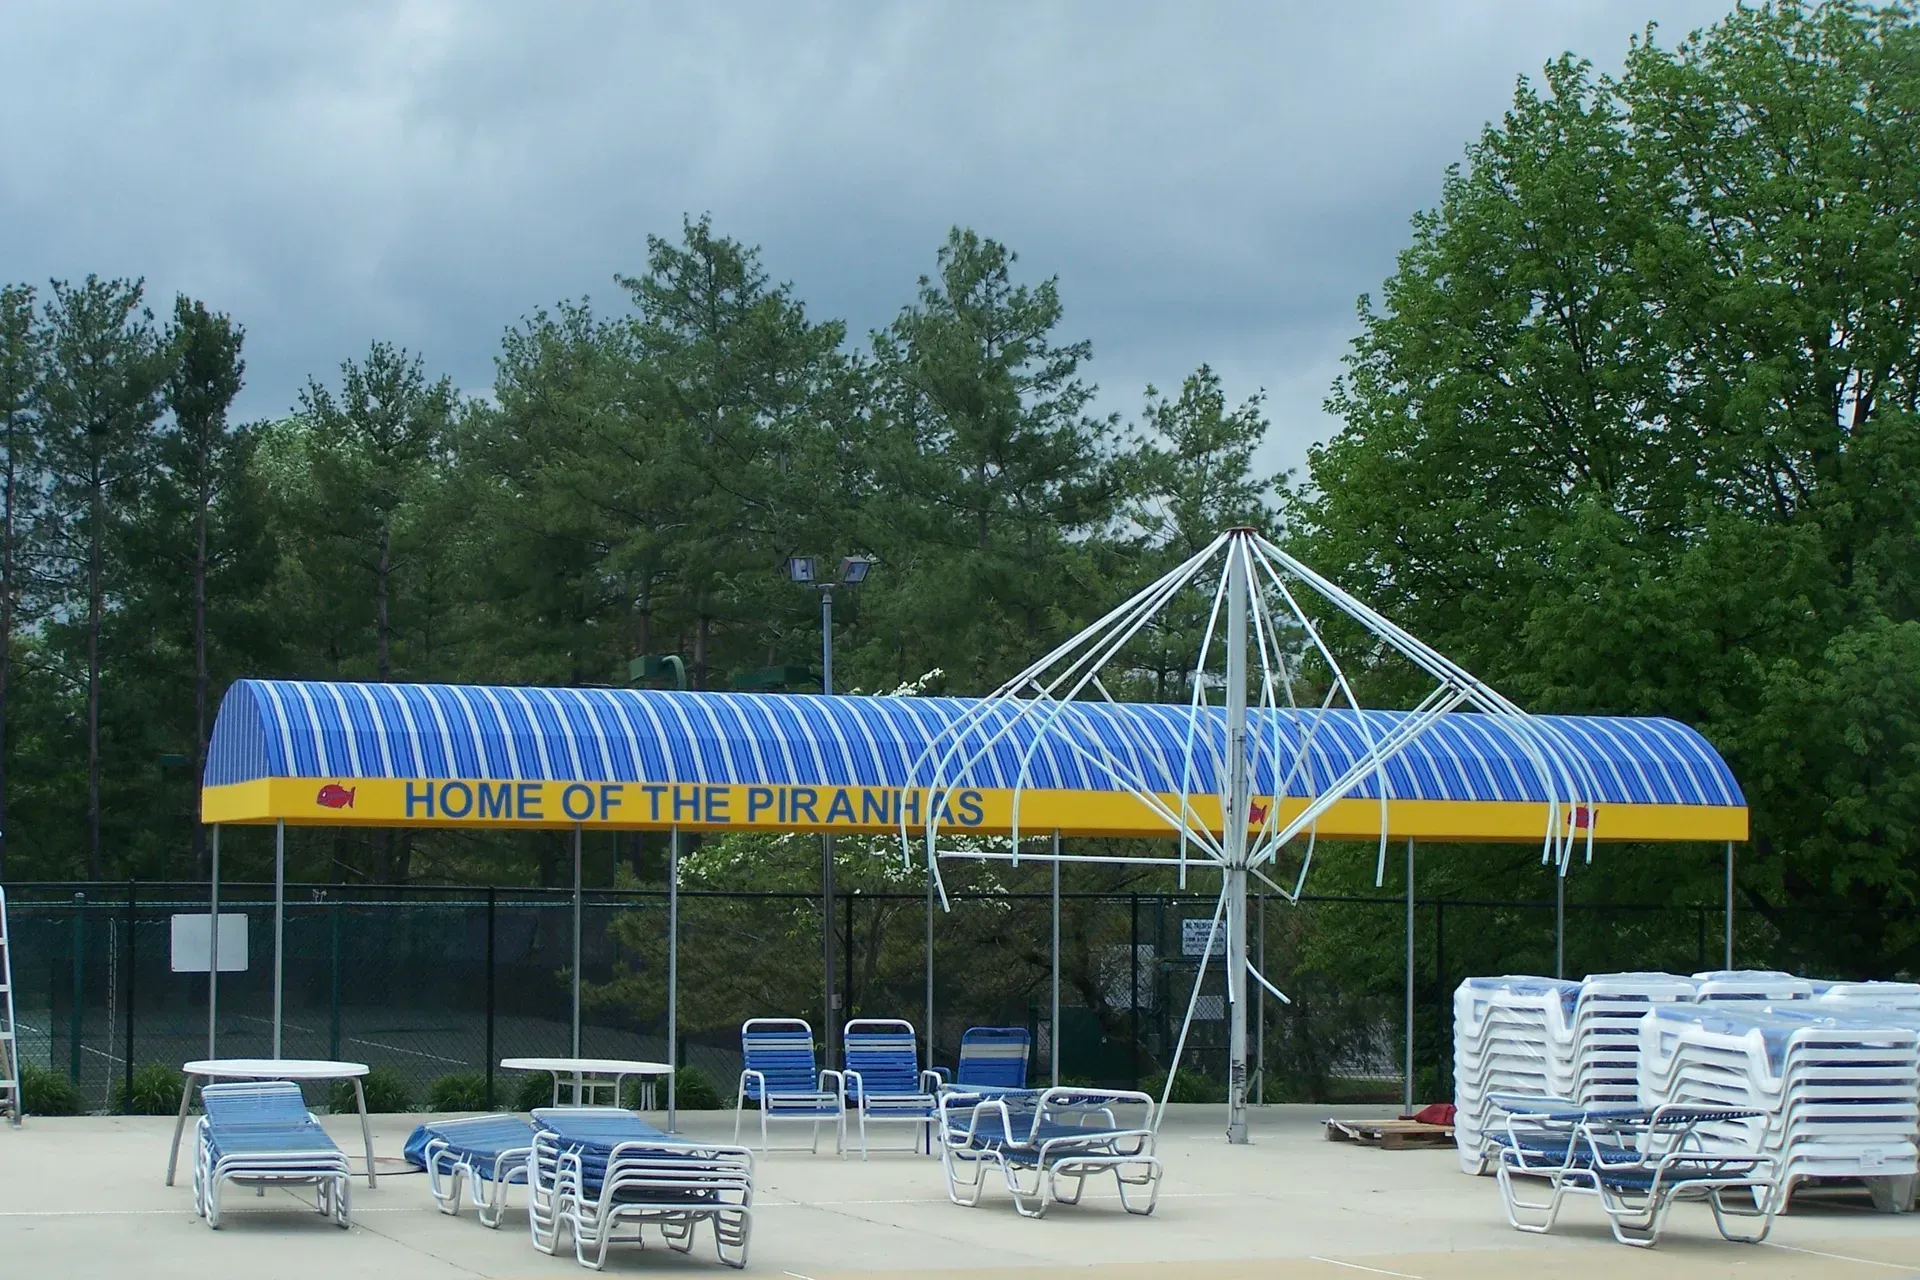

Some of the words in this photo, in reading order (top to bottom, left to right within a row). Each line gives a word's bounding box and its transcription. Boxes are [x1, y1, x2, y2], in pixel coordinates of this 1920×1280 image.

[405, 781, 543, 818] HOME
[562, 783, 622, 819] OF
[641, 785, 731, 821] THE
[748, 788, 984, 826] PIRANHAS
